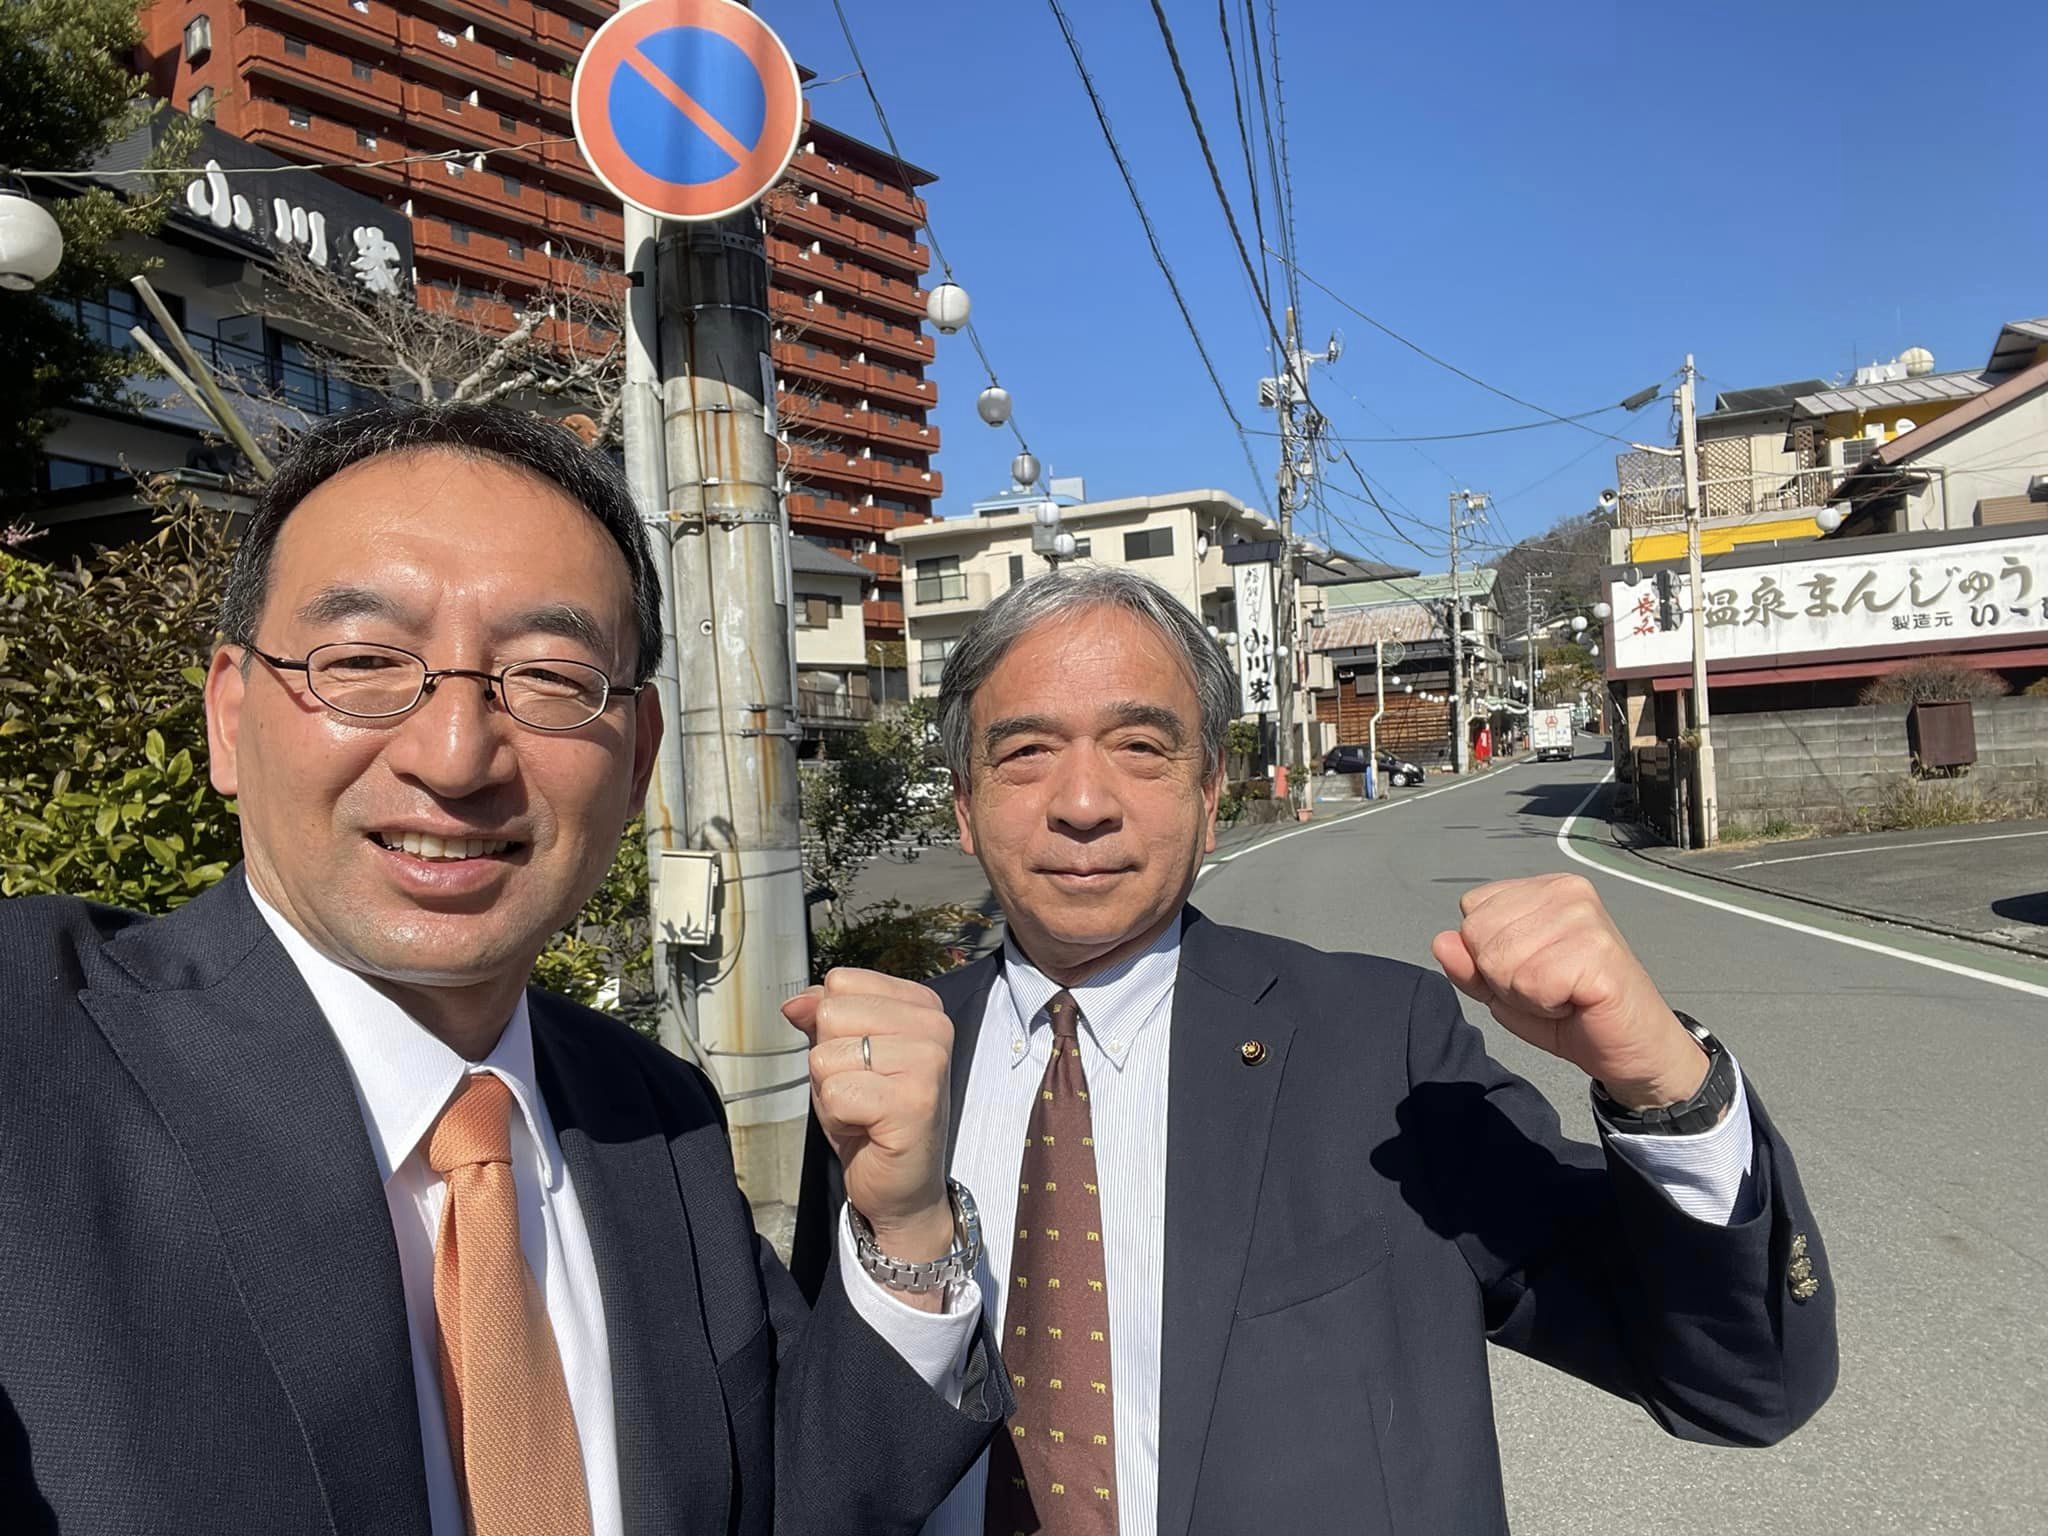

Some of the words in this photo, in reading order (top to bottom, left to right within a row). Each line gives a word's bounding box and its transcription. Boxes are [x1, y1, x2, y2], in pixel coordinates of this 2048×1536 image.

[1703, 556, 2033, 628] 温泉まんじゅう
[1892, 611, 1953, 631] 製造元
